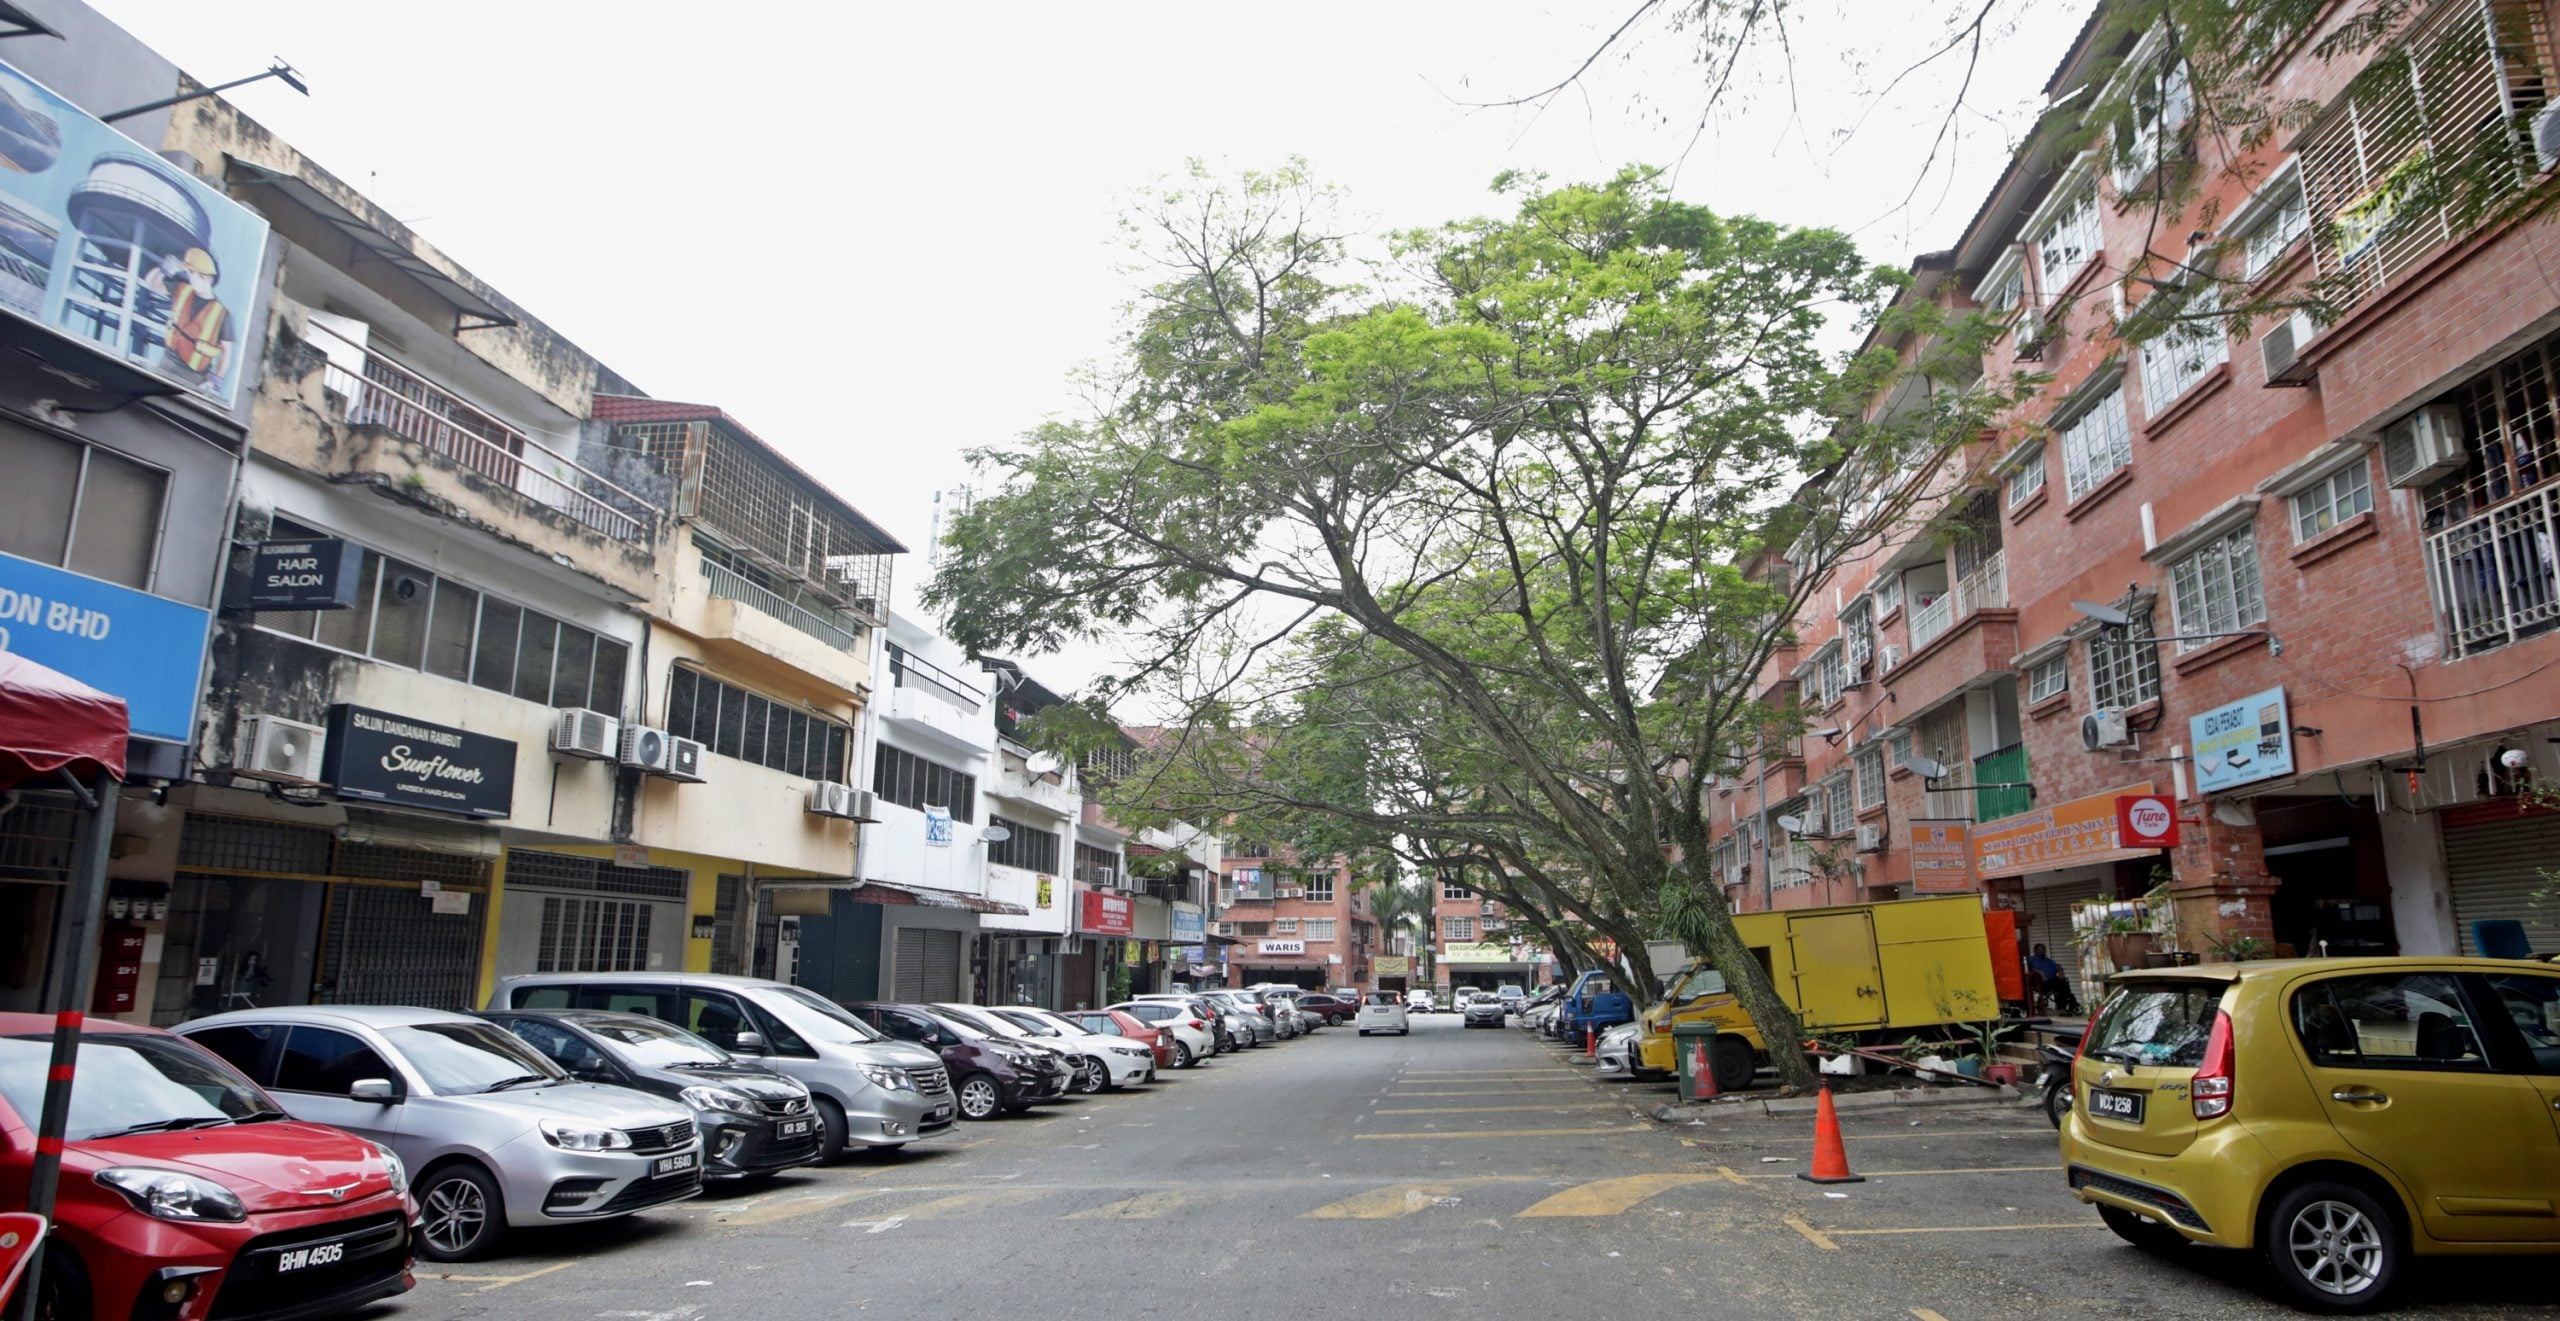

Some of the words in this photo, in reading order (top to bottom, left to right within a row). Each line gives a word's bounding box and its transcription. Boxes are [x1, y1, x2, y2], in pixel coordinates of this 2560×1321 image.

[277, 558, 318, 570] HAIR
[267, 574, 323, 587] SALON
[46, 601, 111, 640] BHD
[384, 720, 430, 742] DANDANAN
[429, 730, 463, 748] RAMBUT
[381, 745, 484, 784] Sunflower
[425, 787, 441, 796] HAIR
[442, 790, 466, 800] SALON
[2133, 808, 2167, 826] Tune
[1265, 943, 1301, 951] WARIS
[2099, 1093, 2114, 1110] VCC
[659, 1158, 673, 1173] VHA
[279, 1249, 309, 1272] BHW
[308, 1243, 344, 1265] 4505
